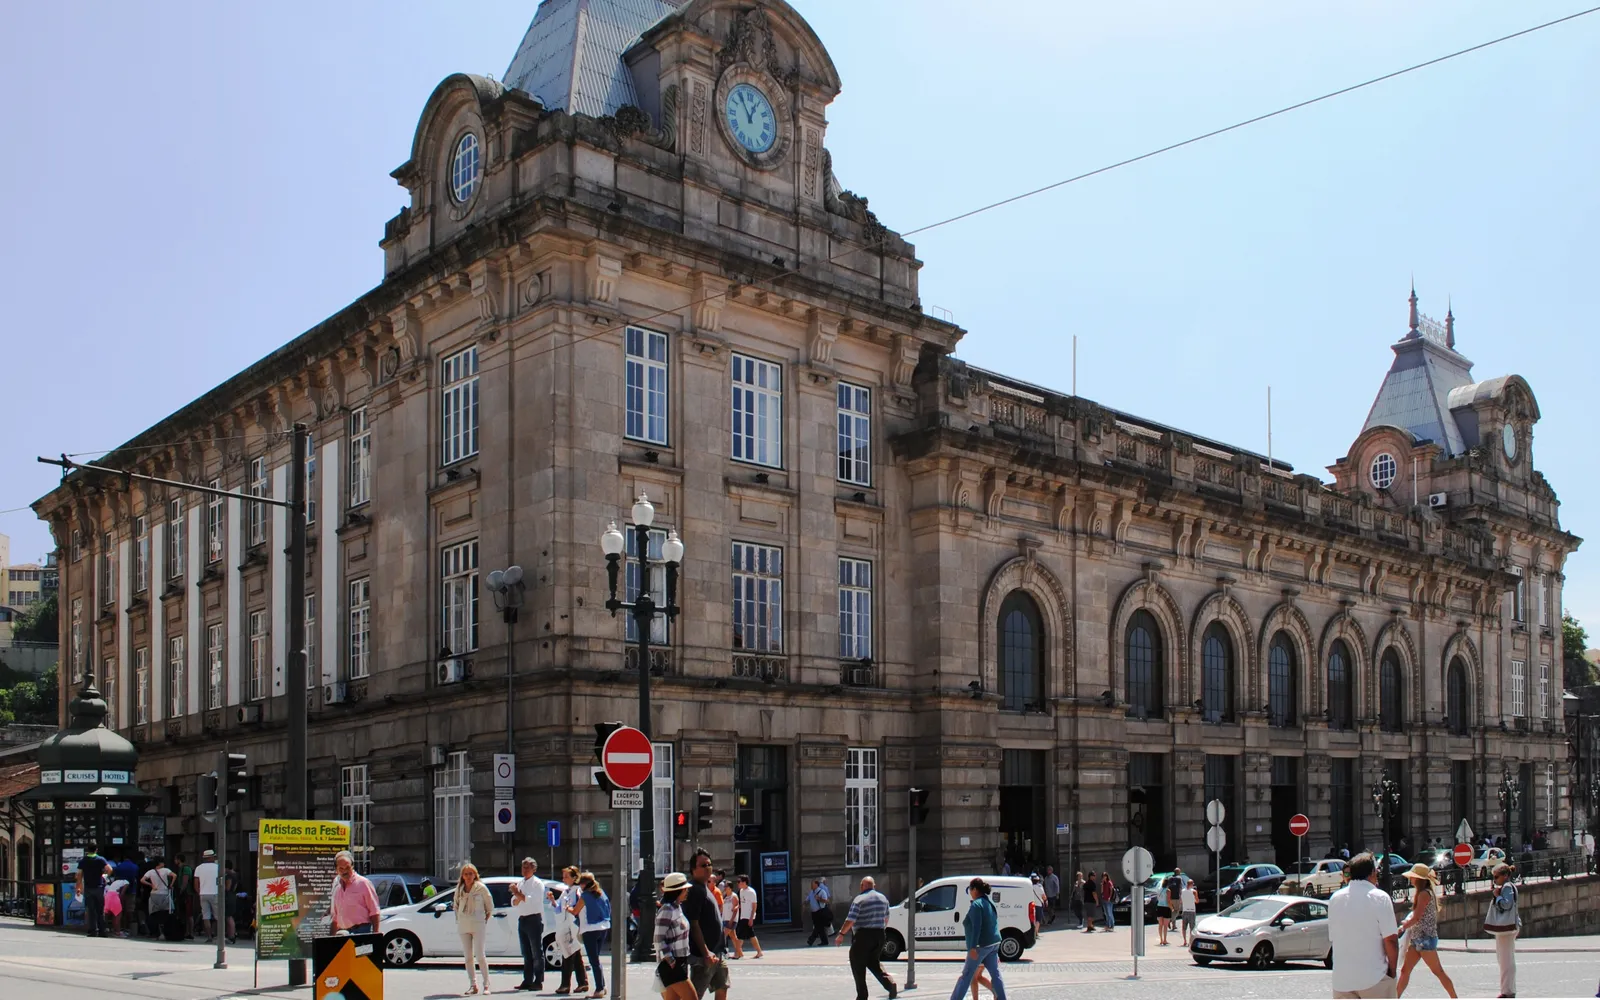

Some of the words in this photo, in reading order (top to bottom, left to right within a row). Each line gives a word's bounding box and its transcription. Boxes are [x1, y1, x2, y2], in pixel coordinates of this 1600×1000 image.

[264, 824, 302, 835] Artistas
[305, 826, 316, 835] na
[320, 825, 346, 836] Festa
[262, 894, 295, 907] Festa
